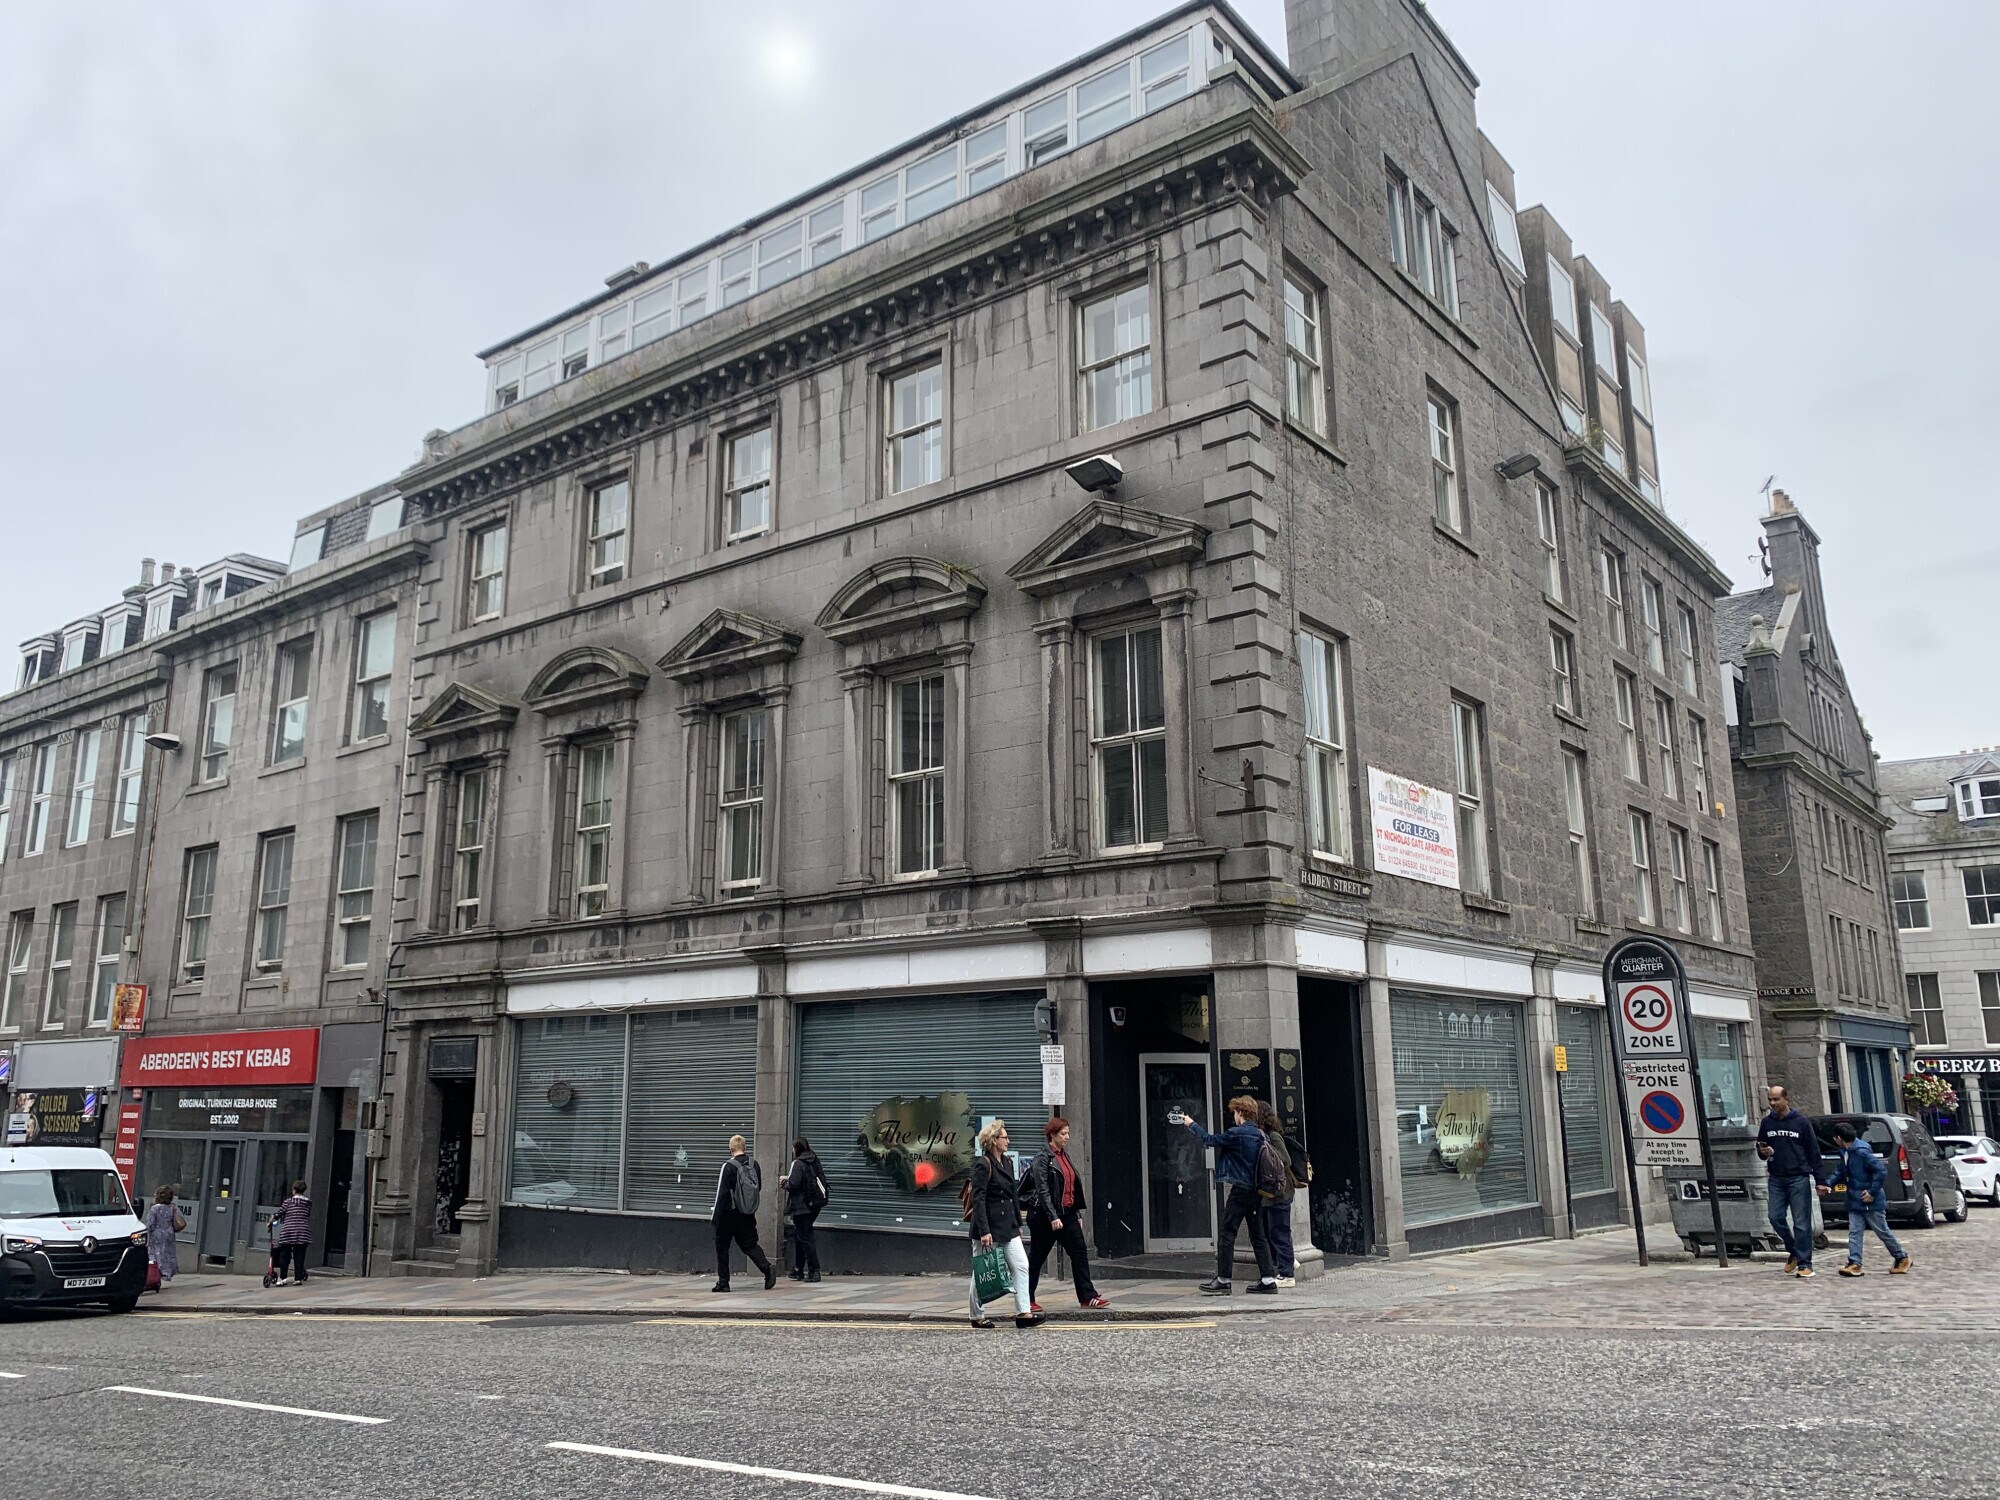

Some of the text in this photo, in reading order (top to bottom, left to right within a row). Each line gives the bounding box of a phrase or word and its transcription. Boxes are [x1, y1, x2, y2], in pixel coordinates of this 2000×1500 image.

[1378, 791, 1388, 803] the
[1395, 821, 1438, 841] FOR LEASE
[1376, 828, 1454, 858] ST NICHOLAS GATE APARTMENTS
[1301, 870, 1361, 895] HADDEN STREET
[1620, 956, 1662, 965] MERCHANT
[1622, 963, 1664, 972] QUARTER
[1632, 999, 1665, 1018] 20
[1630, 1036, 1675, 1048] ZONE
[139, 1048, 290, 1070] ABERDEEN'S BEST KEBAB
[1914, 1059, 1986, 1073] CHEERZ
[1636, 1063, 1685, 1073] estricted
[1637, 1076, 1679, 1087] ZONE
[39, 1094, 68, 1112] GOLDEN
[179, 1099, 277, 1108] ORIGINAL TURKISH KEBAB HOUSE
[43, 1115, 80, 1133] SCISSORS
[210, 1114, 239, 1124] EST. 2002
[1443, 1112, 1484, 1143] The Spa
[874, 1120, 959, 1154] The Spa
[876, 1152, 957, 1163] SALON SPA CLINIC
[979, 1269, 996, 1284] M&S
